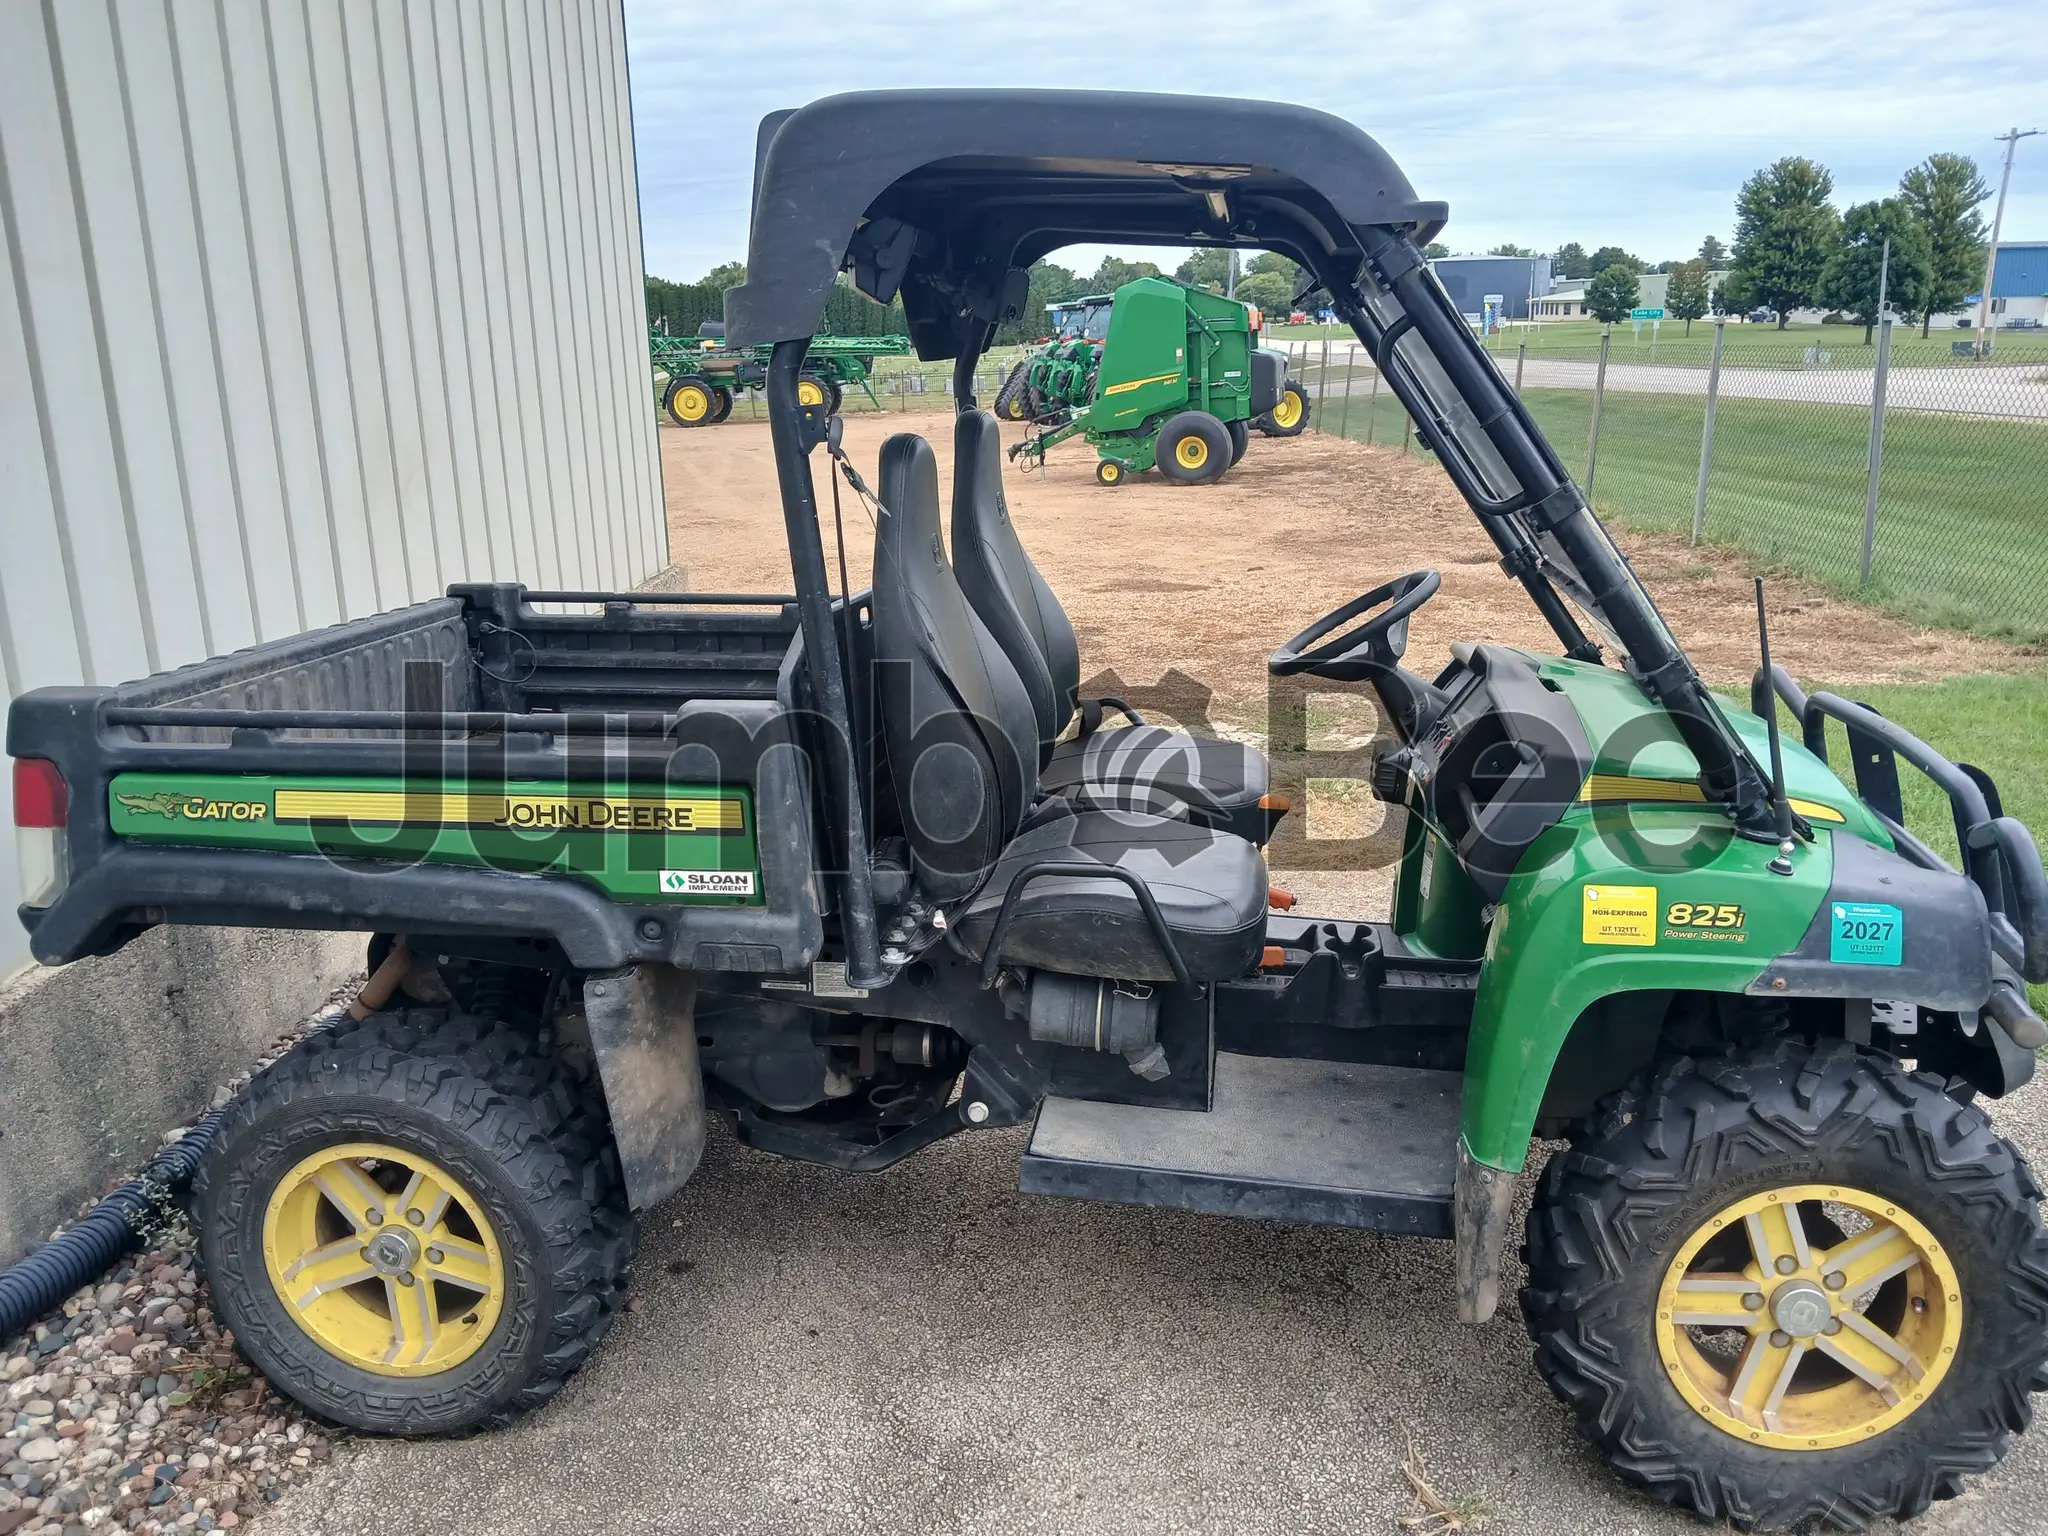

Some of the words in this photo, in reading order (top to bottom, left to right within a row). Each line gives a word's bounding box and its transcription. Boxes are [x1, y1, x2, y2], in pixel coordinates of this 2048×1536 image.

[183, 797, 267, 821] GATOR
[494, 799, 580, 826] JOHN
[587, 800, 694, 828] DEERE
[687, 874, 749, 885] SLOAN
[688, 884, 749, 892] IMPLEMENT
[1591, 909, 1648, 917] NON-EXPIRING
[1666, 903, 1745, 928] 825i
[1664, 929, 1698, 939] Power
[1700, 931, 1745, 942] Steering
[1840, 920, 1895, 941] 2027
